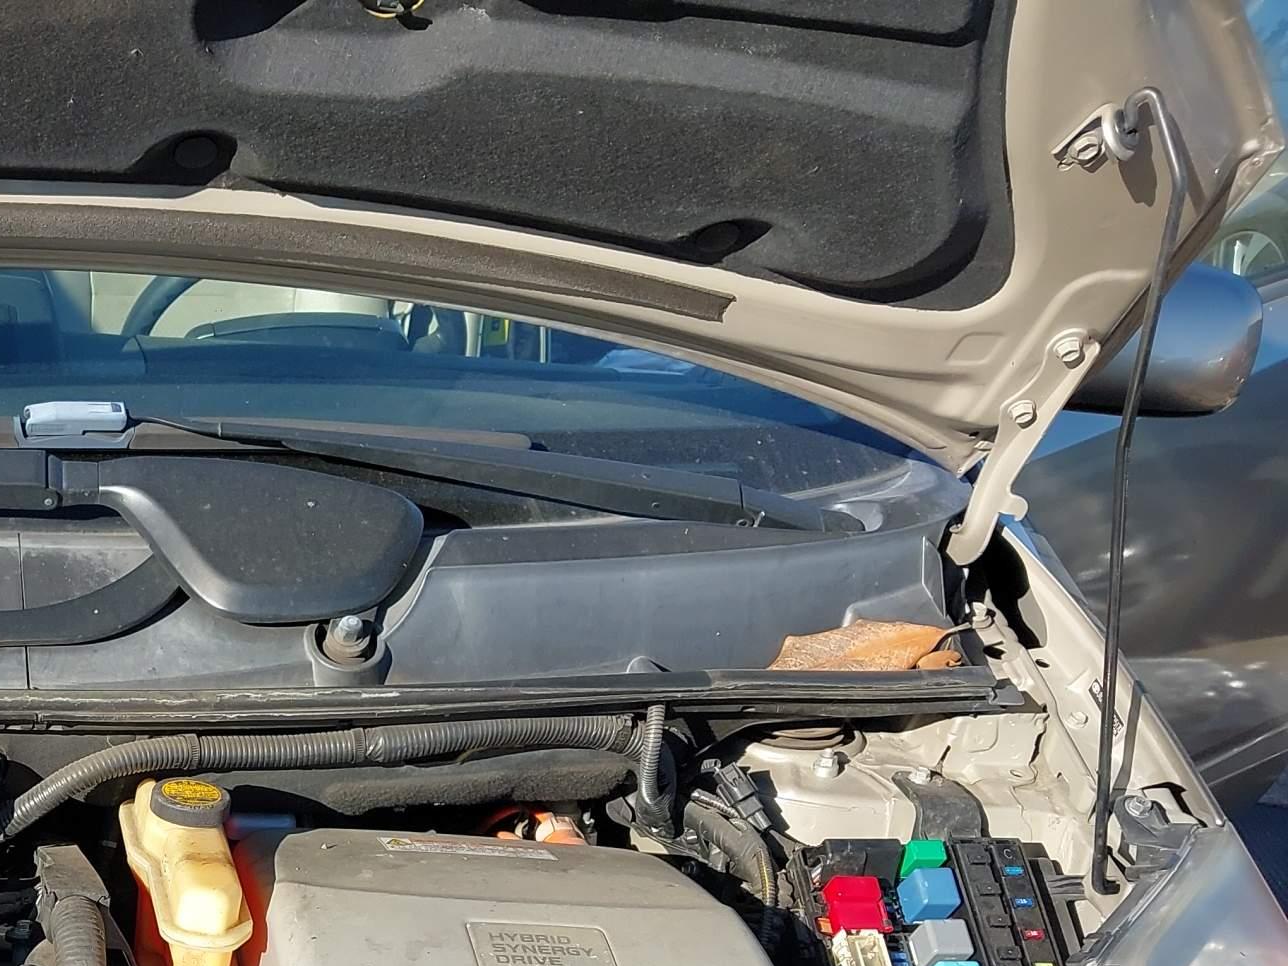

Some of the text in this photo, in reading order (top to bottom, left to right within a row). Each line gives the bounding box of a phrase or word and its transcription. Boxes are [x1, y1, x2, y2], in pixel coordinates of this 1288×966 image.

[488, 932, 571, 945] HYBRID
[492, 943, 593, 957] SYNERGY
[496, 954, 563, 966] DRIVE
